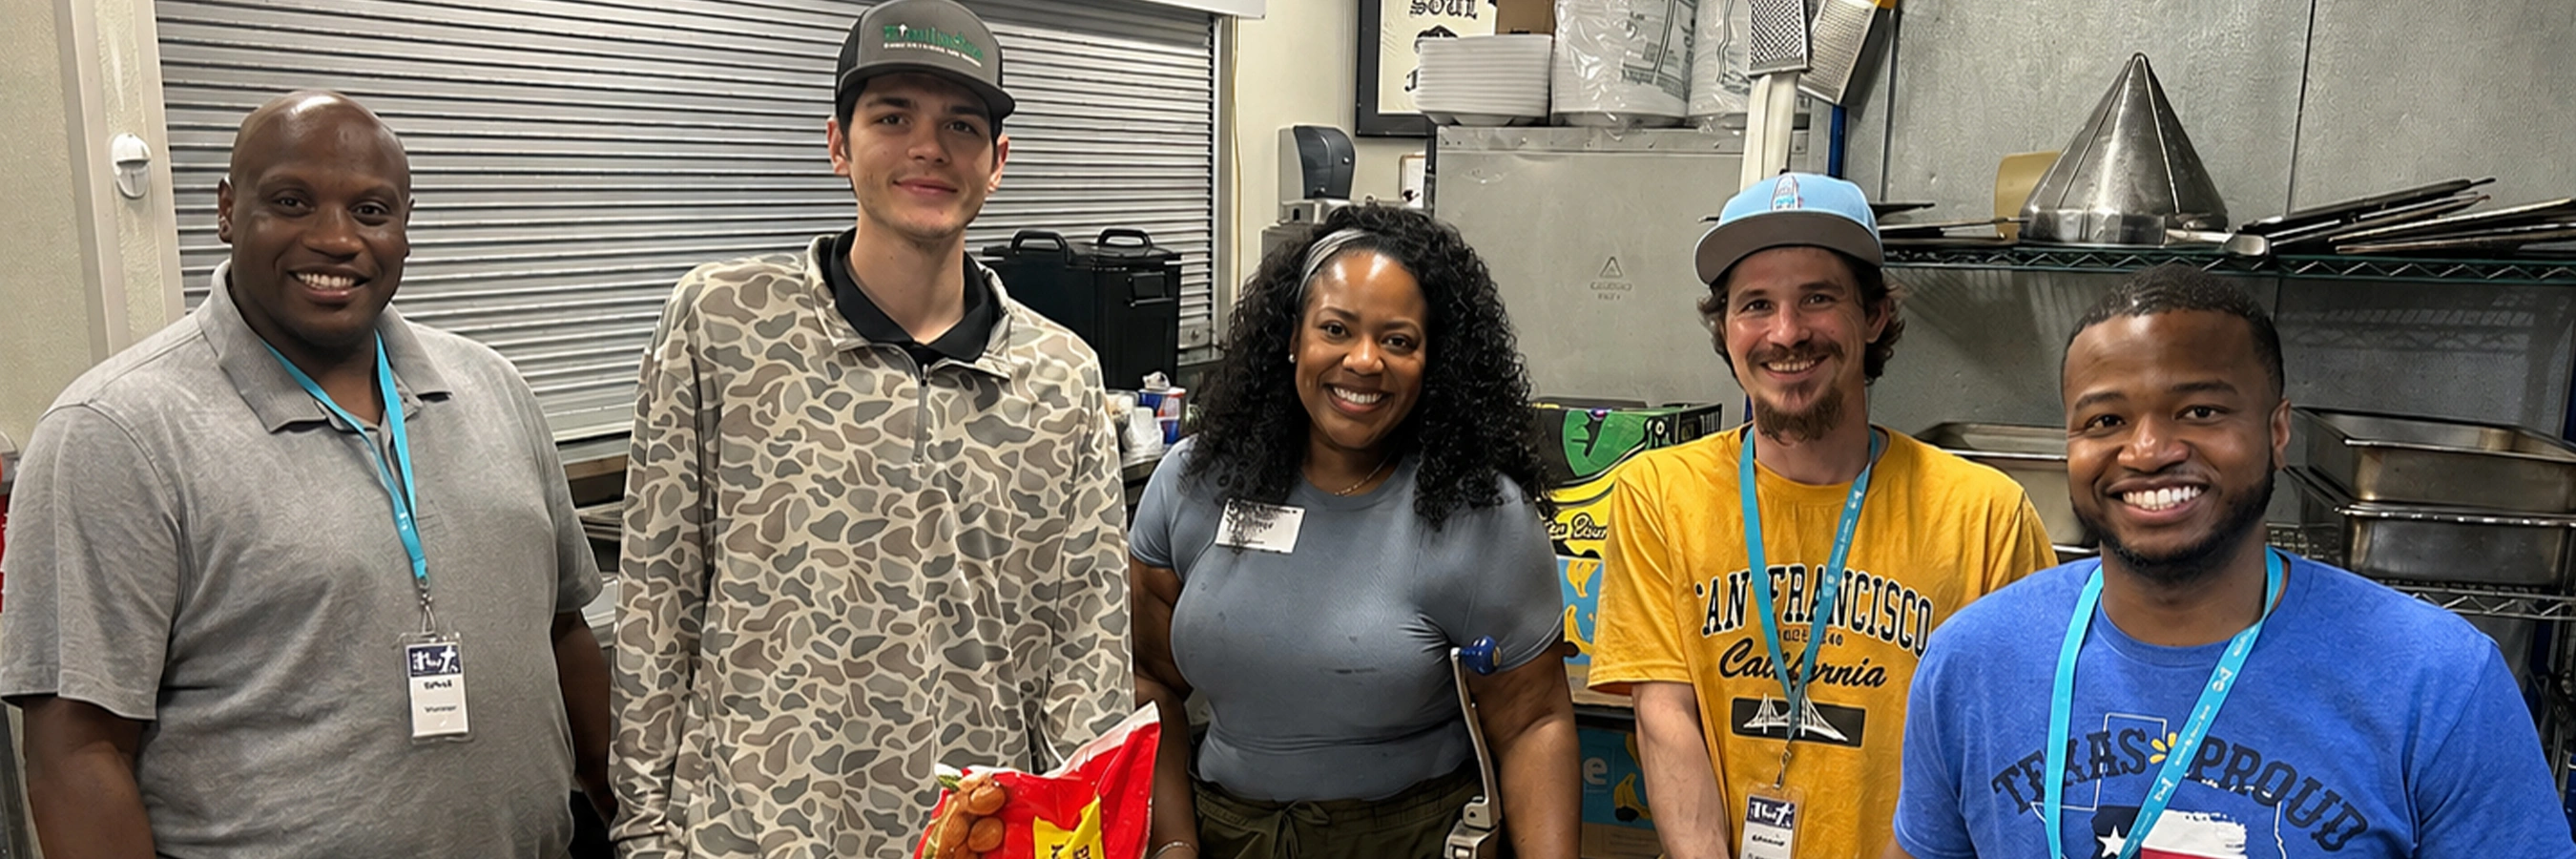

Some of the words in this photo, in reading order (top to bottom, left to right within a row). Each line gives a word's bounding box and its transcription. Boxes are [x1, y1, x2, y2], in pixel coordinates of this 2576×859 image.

[1695, 570, 1751, 637] AN
[1765, 563, 1932, 659] FRANCISCO
[1719, 638, 1886, 687] Calfrnia
[2185, 737, 2368, 851] PROUD
